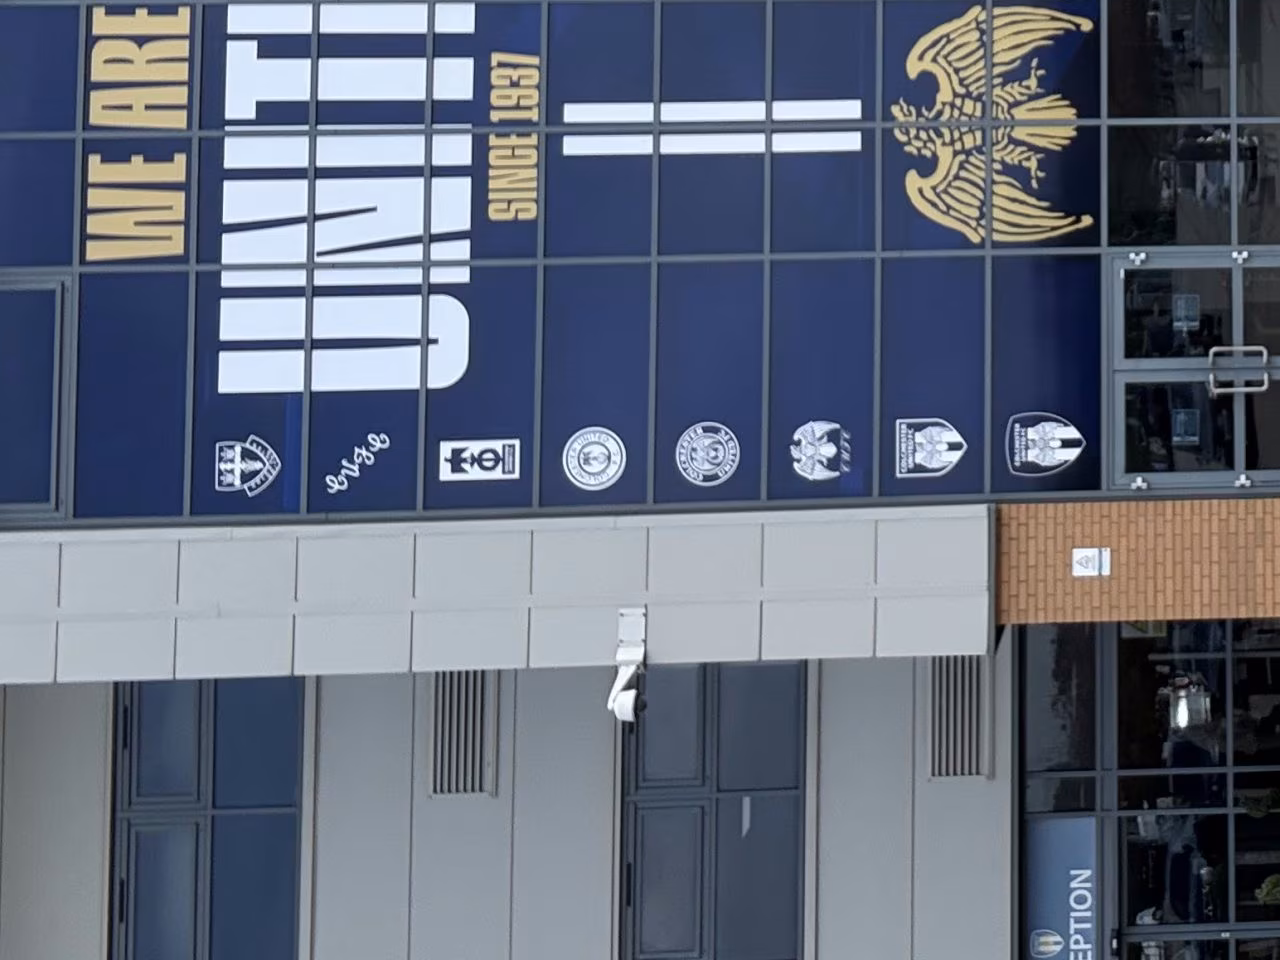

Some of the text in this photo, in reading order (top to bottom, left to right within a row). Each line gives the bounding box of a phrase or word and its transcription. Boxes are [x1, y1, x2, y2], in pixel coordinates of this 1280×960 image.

[85, 5, 190, 261] WE ARE
[487, 51, 541, 221] SINCE 1937
